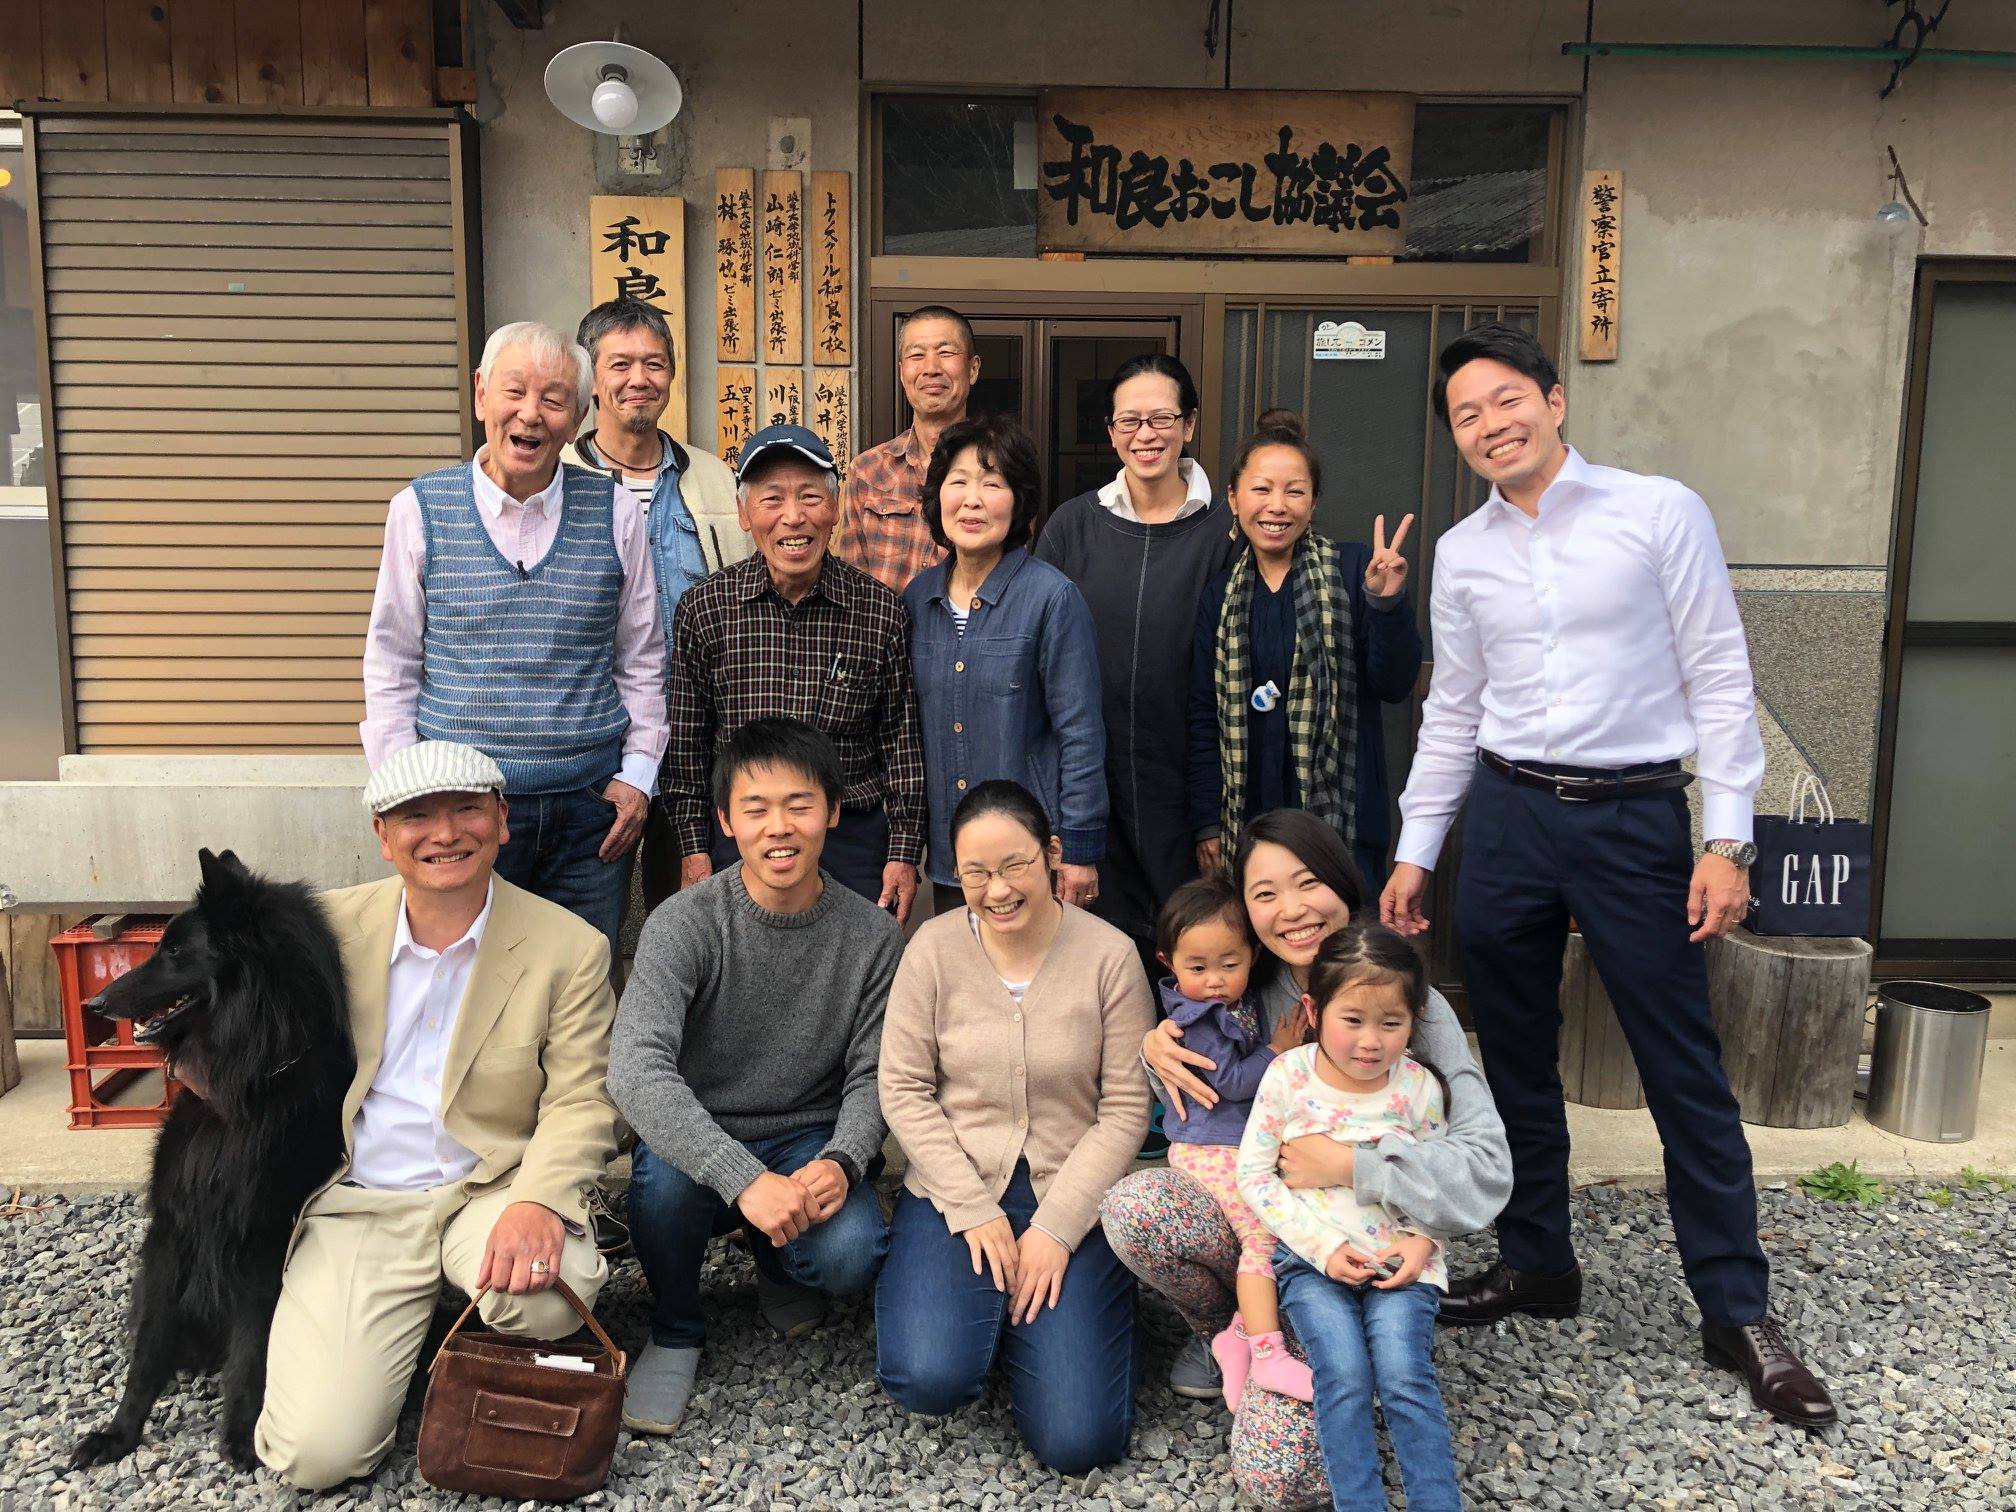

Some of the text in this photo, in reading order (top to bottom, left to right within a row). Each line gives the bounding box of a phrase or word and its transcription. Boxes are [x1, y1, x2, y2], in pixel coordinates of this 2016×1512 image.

[1043, 113, 1408, 233] 和良おこし協議会
[1590, 184, 1618, 342] 警察官立寄所
[719, 384, 741, 475] 五十川飛
[1781, 853, 1850, 906] GAP
